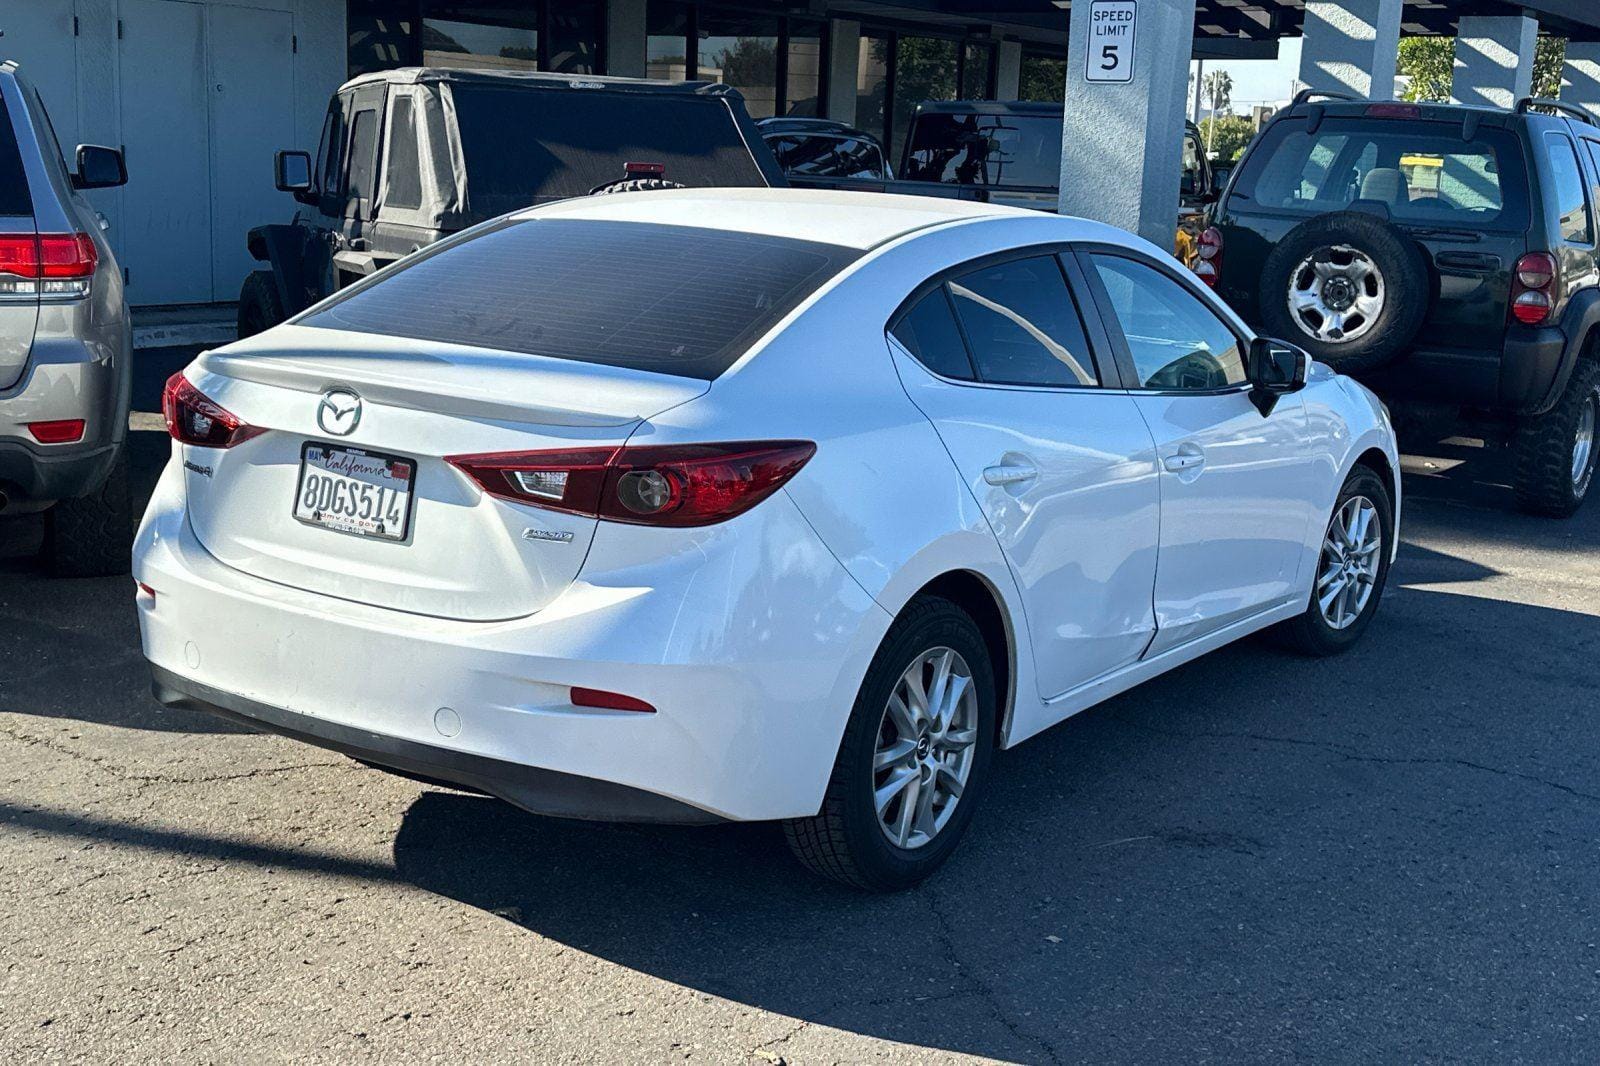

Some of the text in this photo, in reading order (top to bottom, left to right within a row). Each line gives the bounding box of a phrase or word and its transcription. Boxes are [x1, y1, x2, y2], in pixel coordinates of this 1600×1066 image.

[1093, 10, 1133, 21] SPEED
[1096, 25, 1128, 36] LIMIT
[1101, 45, 1119, 71] 5
[325, 452, 392, 479] California
[303, 474, 400, 525] 8DGS514
